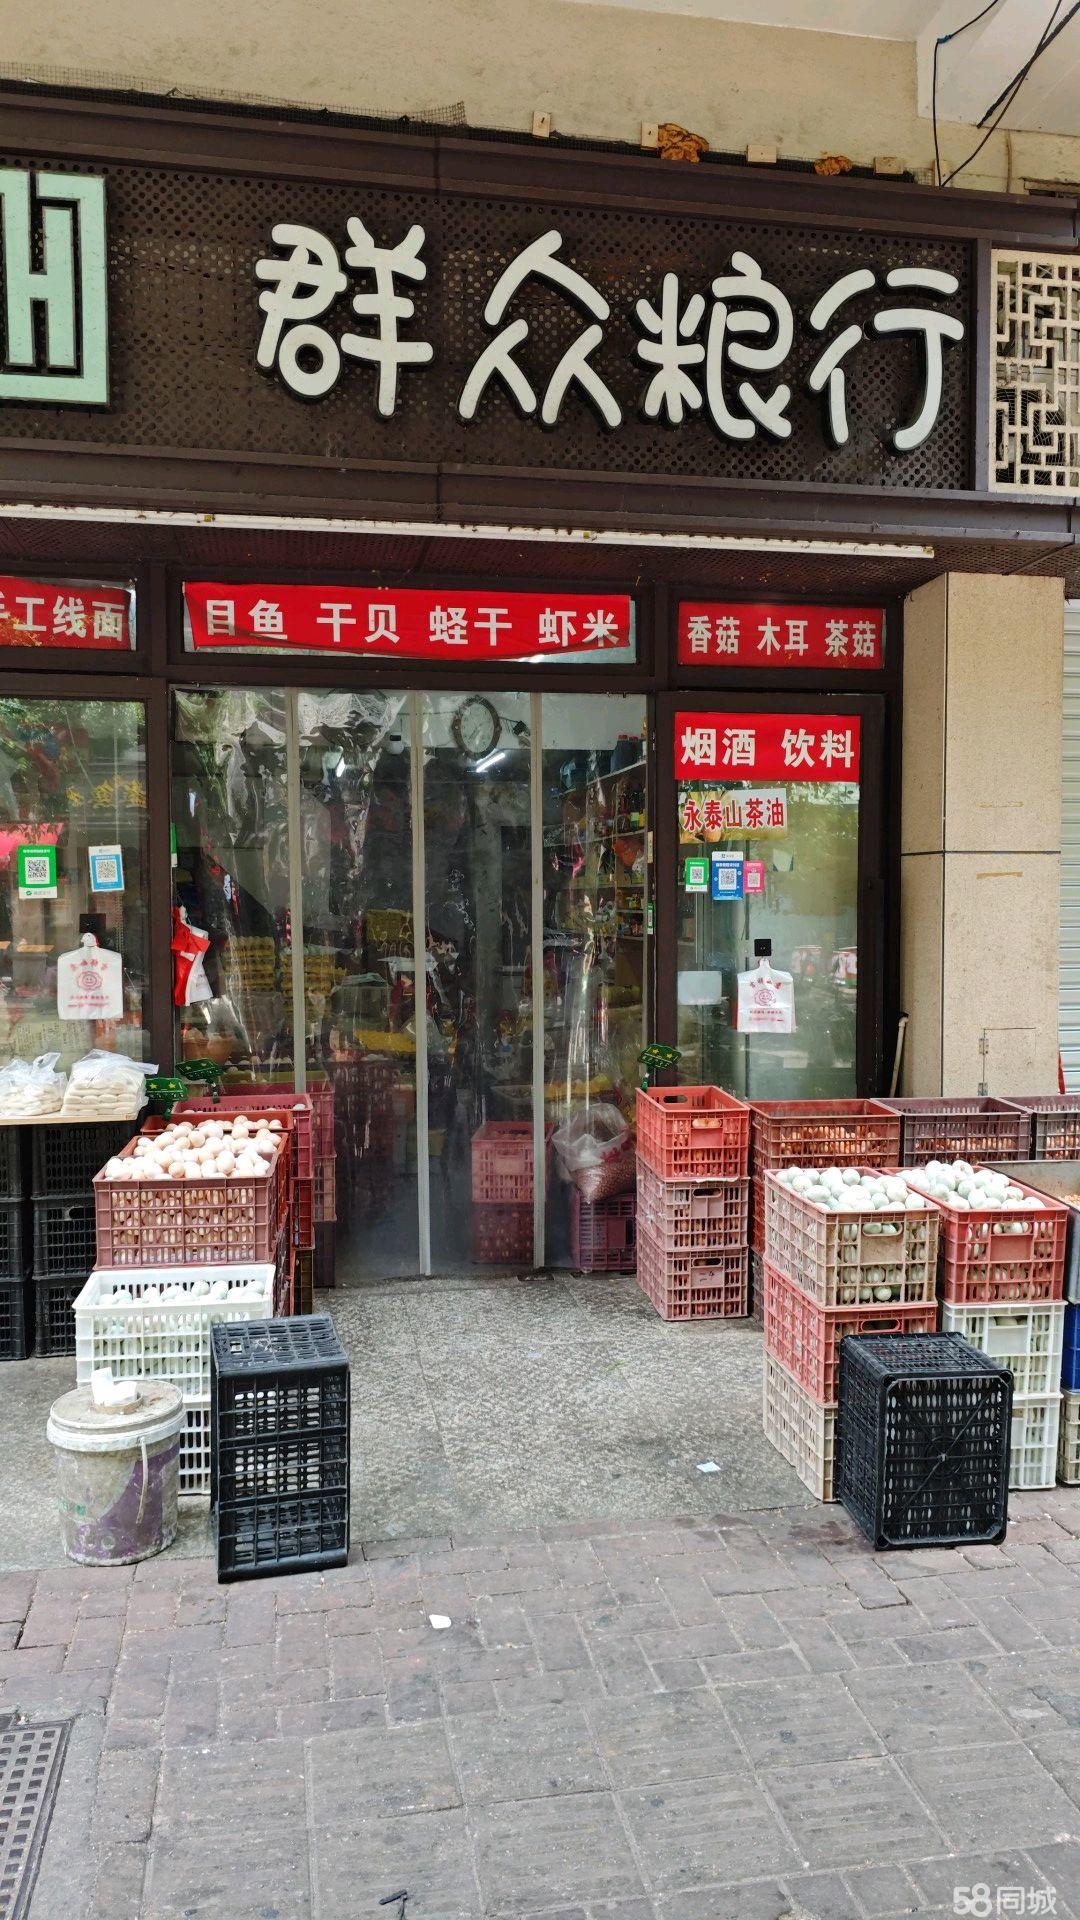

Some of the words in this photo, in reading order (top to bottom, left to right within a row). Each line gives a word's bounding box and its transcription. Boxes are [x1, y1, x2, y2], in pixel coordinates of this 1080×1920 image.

[255, 216, 965, 450] 群众粮行
[206, 599, 288, 639] 目鱼
[316, 602, 400, 644] 干贝
[429, 605, 512, 646] 蛏干
[538, 608, 619, 647] 虾米
[687, 616, 740, 654] 香菇
[757, 617, 808, 656] 木耳
[825, 619, 876, 657] 茶菇
[680, 727, 756, 766] 烟酒
[781, 728, 855, 768] 饮料
[682, 796, 785, 831] 永泰山茶油
